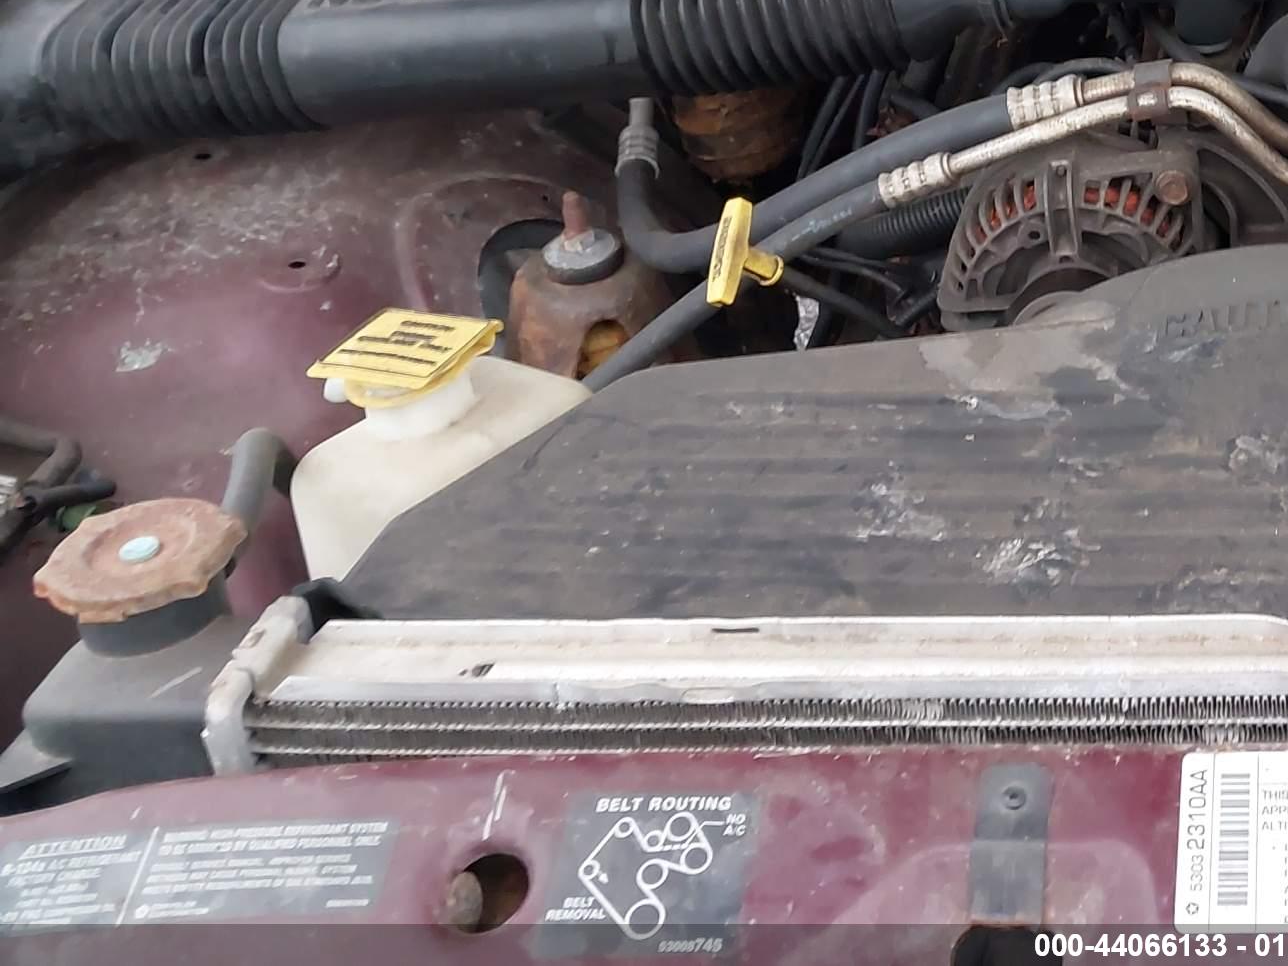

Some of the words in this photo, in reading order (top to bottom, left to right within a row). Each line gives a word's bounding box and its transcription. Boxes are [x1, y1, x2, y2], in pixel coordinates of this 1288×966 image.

[596, 797, 644, 813] BELT
[648, 796, 732, 812] ROUTING
[726, 813, 746, 825] NO
[723, 824, 746, 836] A/C
[25, 835, 127, 855] ATTENTION
[563, 897, 596, 908] BELT
[545, 908, 607, 922] REMOVAL
